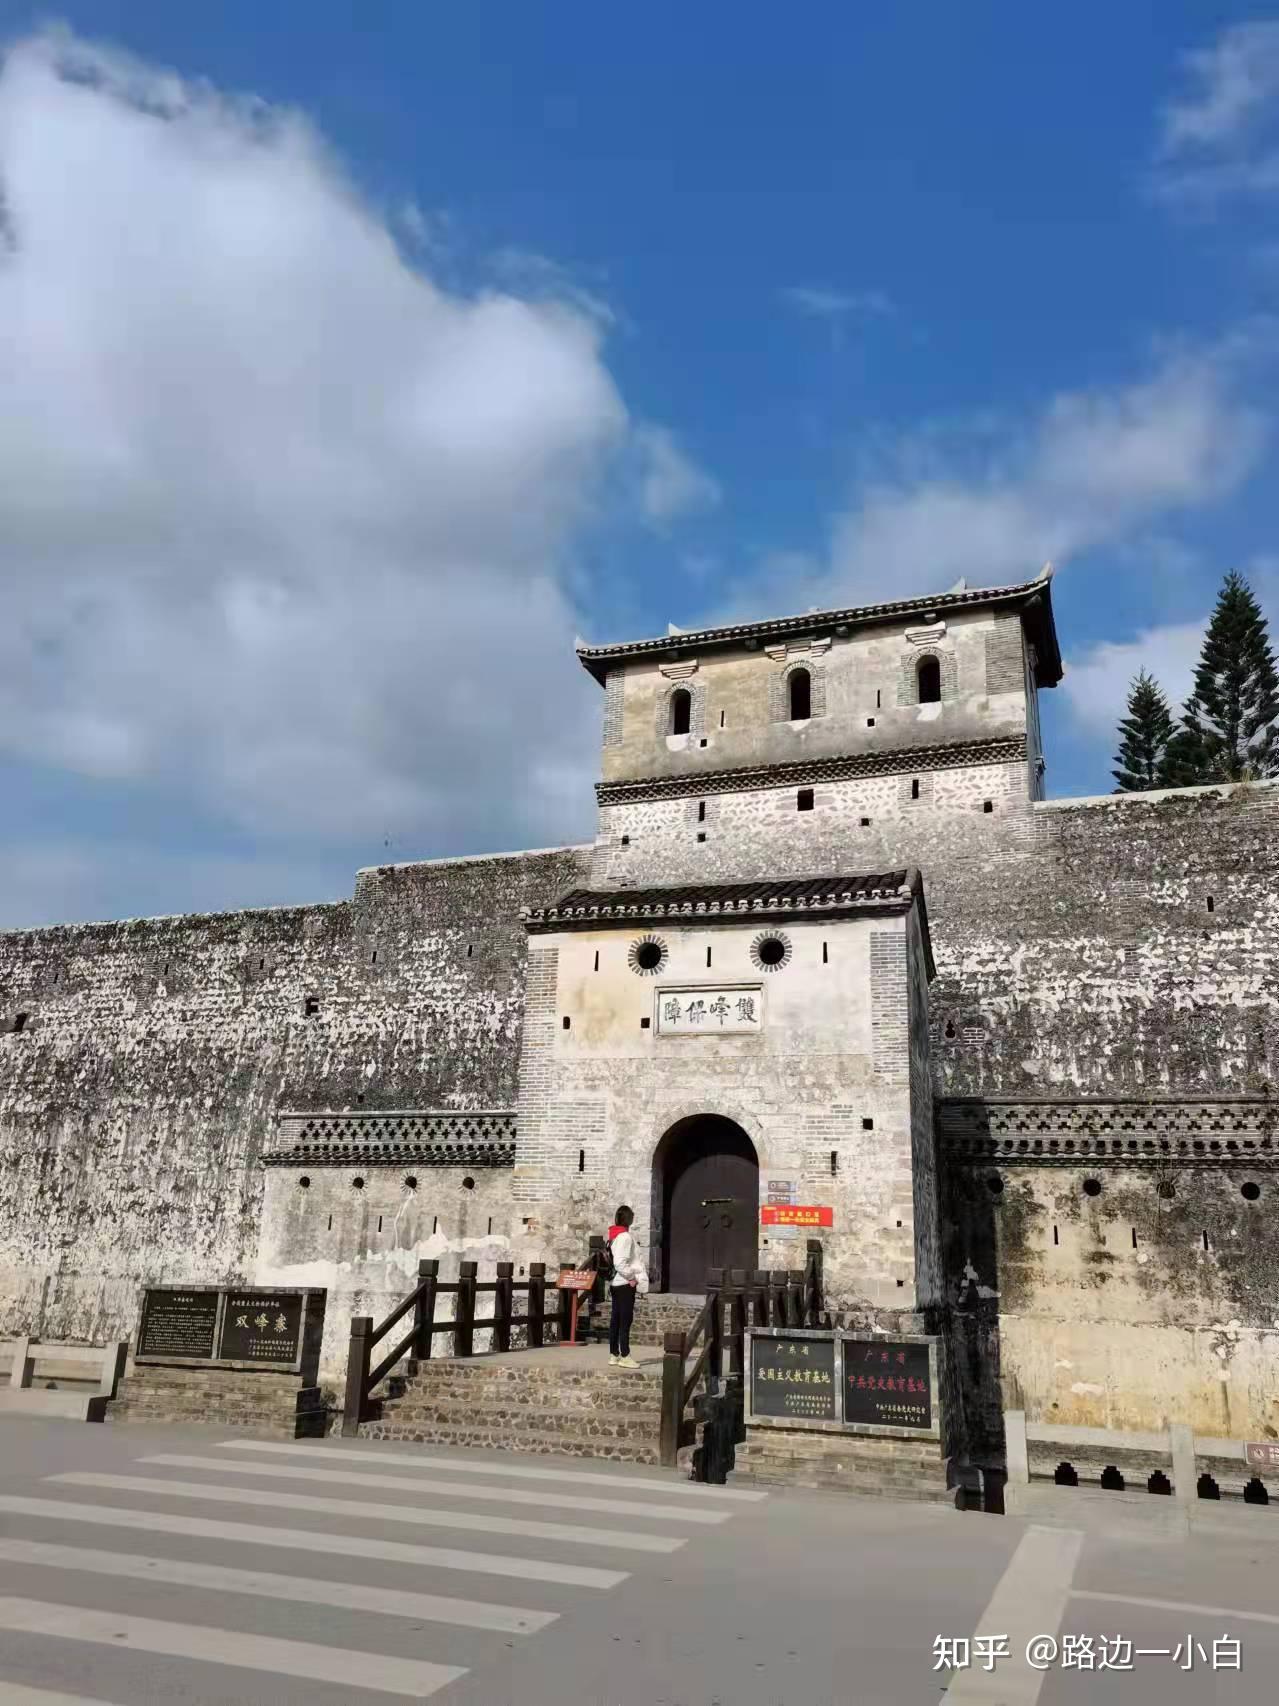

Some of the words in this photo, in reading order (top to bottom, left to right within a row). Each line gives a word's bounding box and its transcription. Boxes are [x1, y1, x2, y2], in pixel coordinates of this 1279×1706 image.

[235, 1312, 288, 1333] 双峰寨
[775, 1343, 809, 1356] 广东省
[864, 1349, 905, 1365] 广东省
[757, 1367, 831, 1383] 爱国主义教育基地
[847, 1375, 928, 1392] 中共党史教育基地
